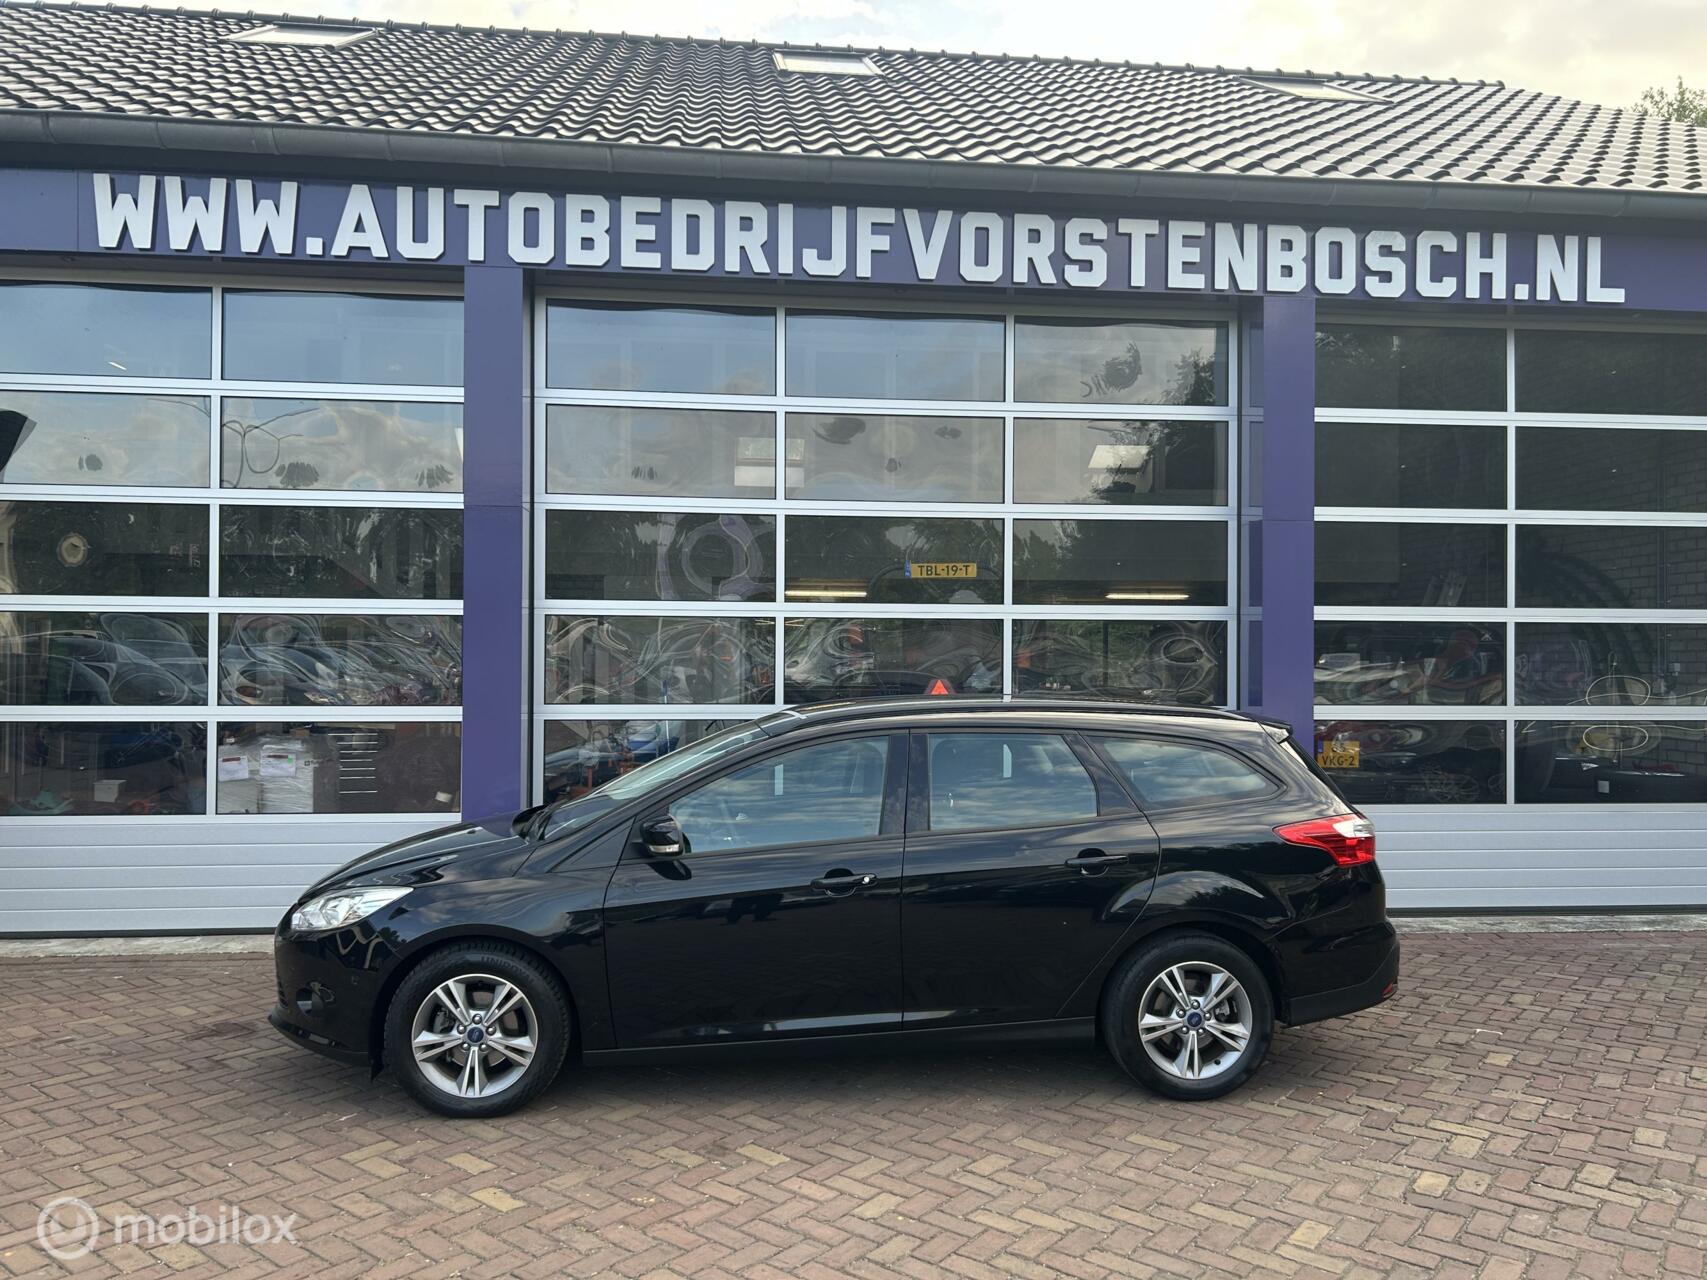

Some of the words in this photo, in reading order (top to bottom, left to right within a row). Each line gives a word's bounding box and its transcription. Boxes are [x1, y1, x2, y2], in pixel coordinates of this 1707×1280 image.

[93, 173, 1626, 303] WWW.AUTOBEDRIJFVORSTENBOSCH.NL
[917, 564, 971, 577] TBL-19-T
[1321, 755, 1356, 767] VKG-2
